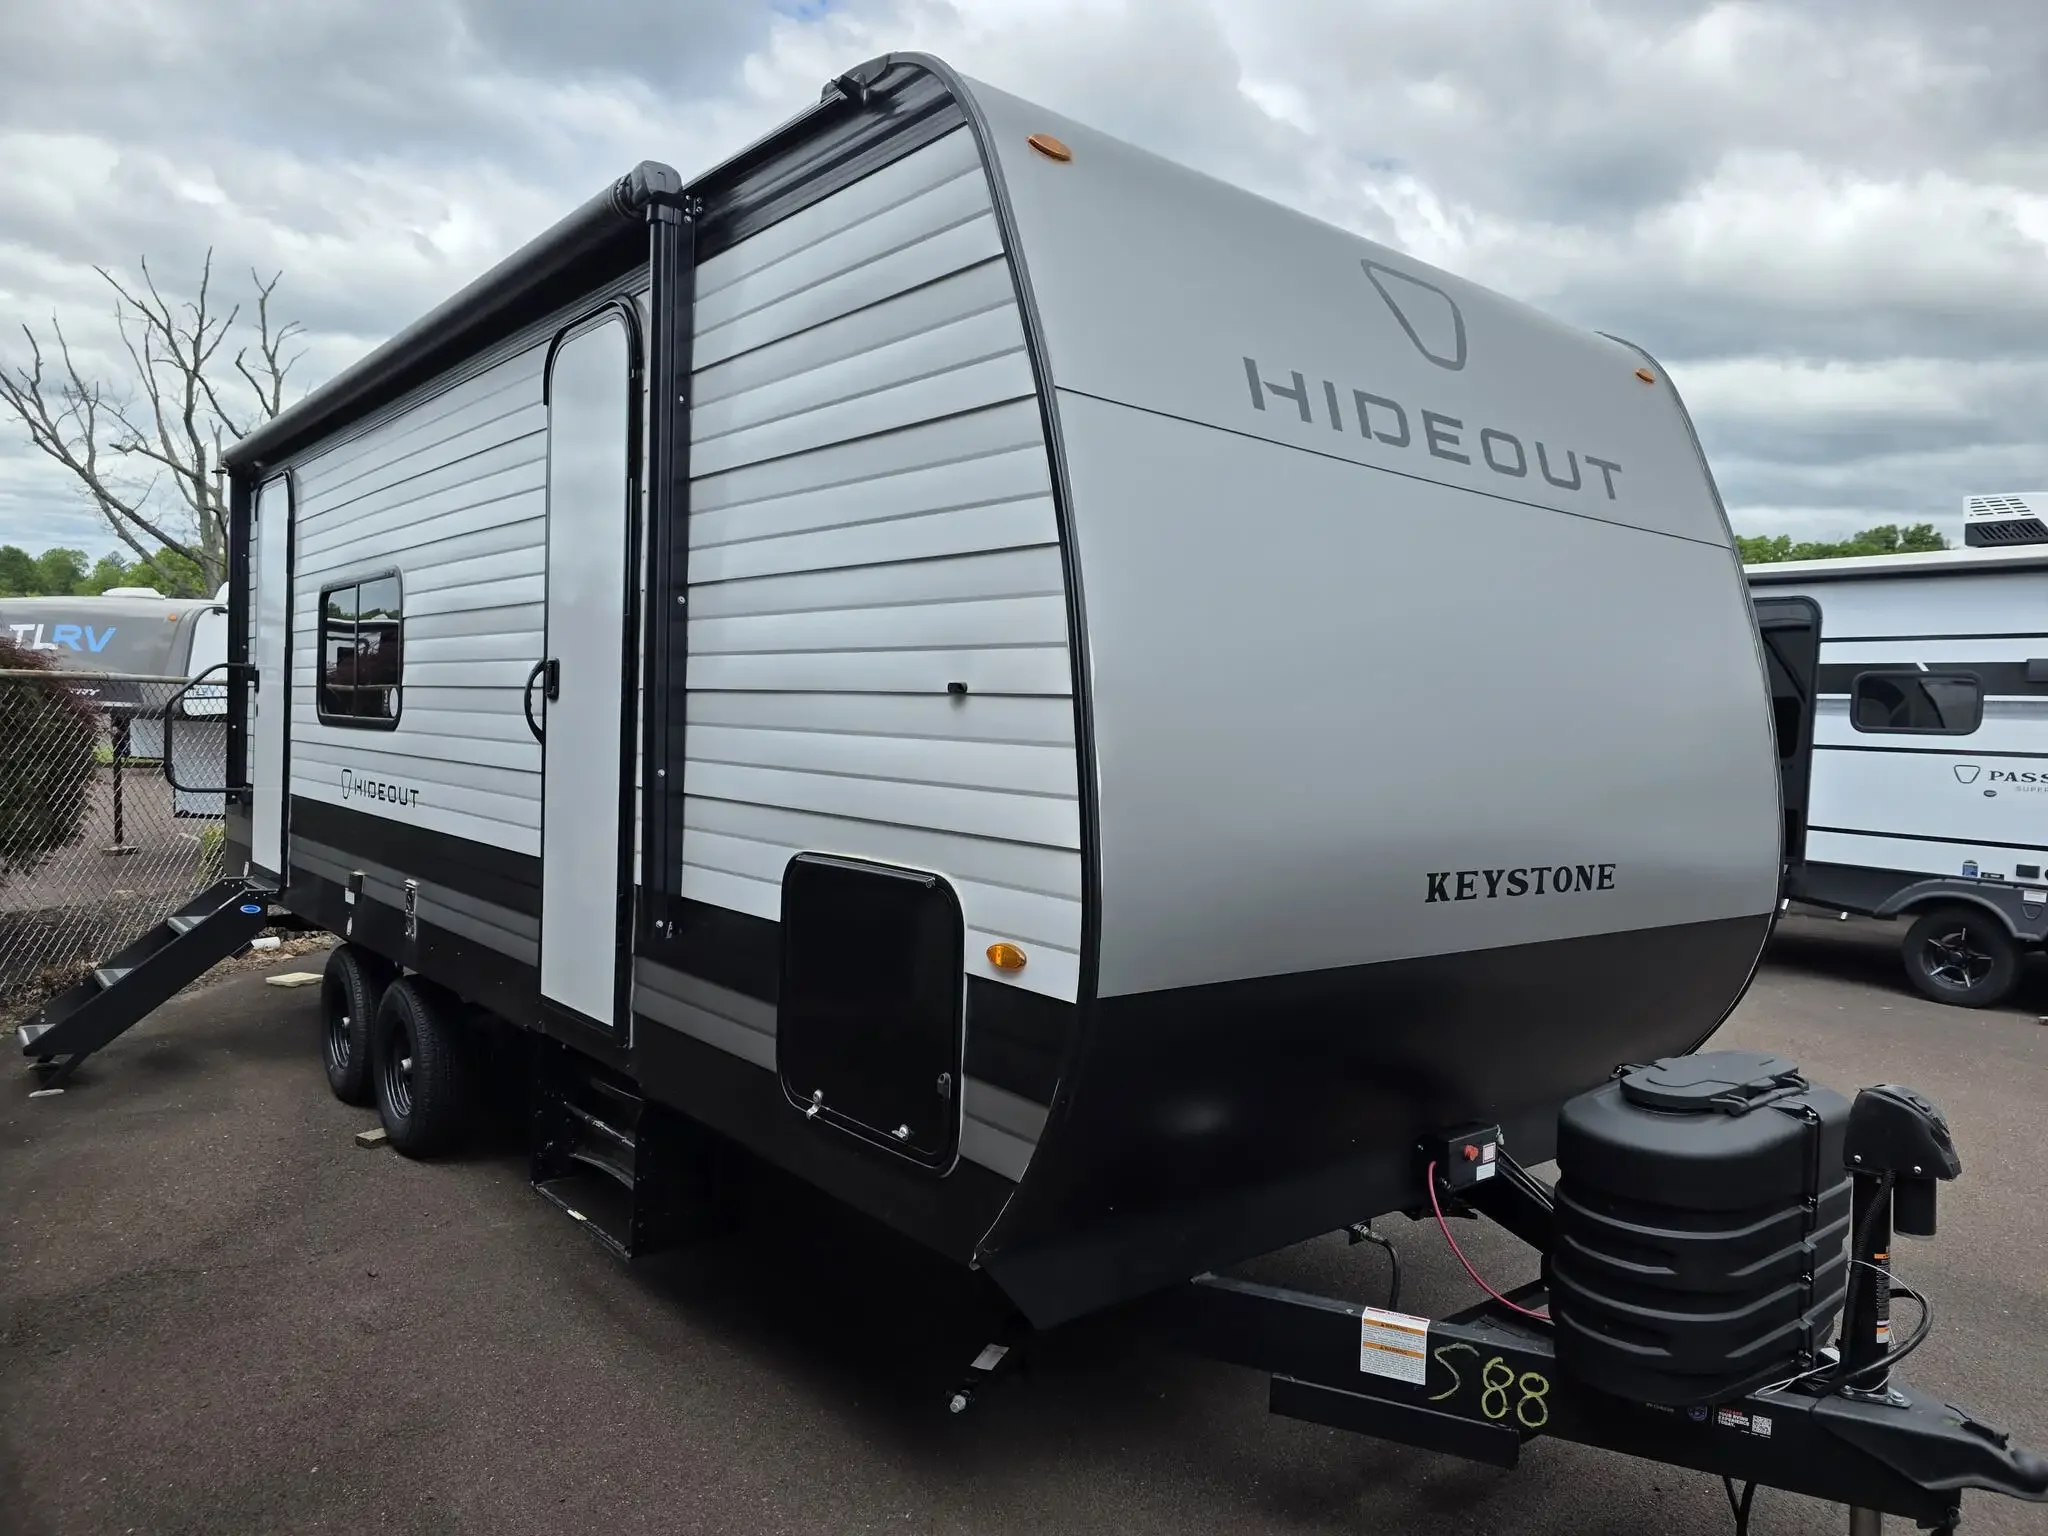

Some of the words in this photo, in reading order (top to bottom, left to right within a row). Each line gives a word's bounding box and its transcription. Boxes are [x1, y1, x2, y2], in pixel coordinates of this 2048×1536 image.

[1243, 356, 1622, 500] HIDEOUT
[9, 623, 117, 652] TLRV
[354, 778, 419, 808] HIDEOUT
[1425, 863, 1616, 903] KEYSTONE
